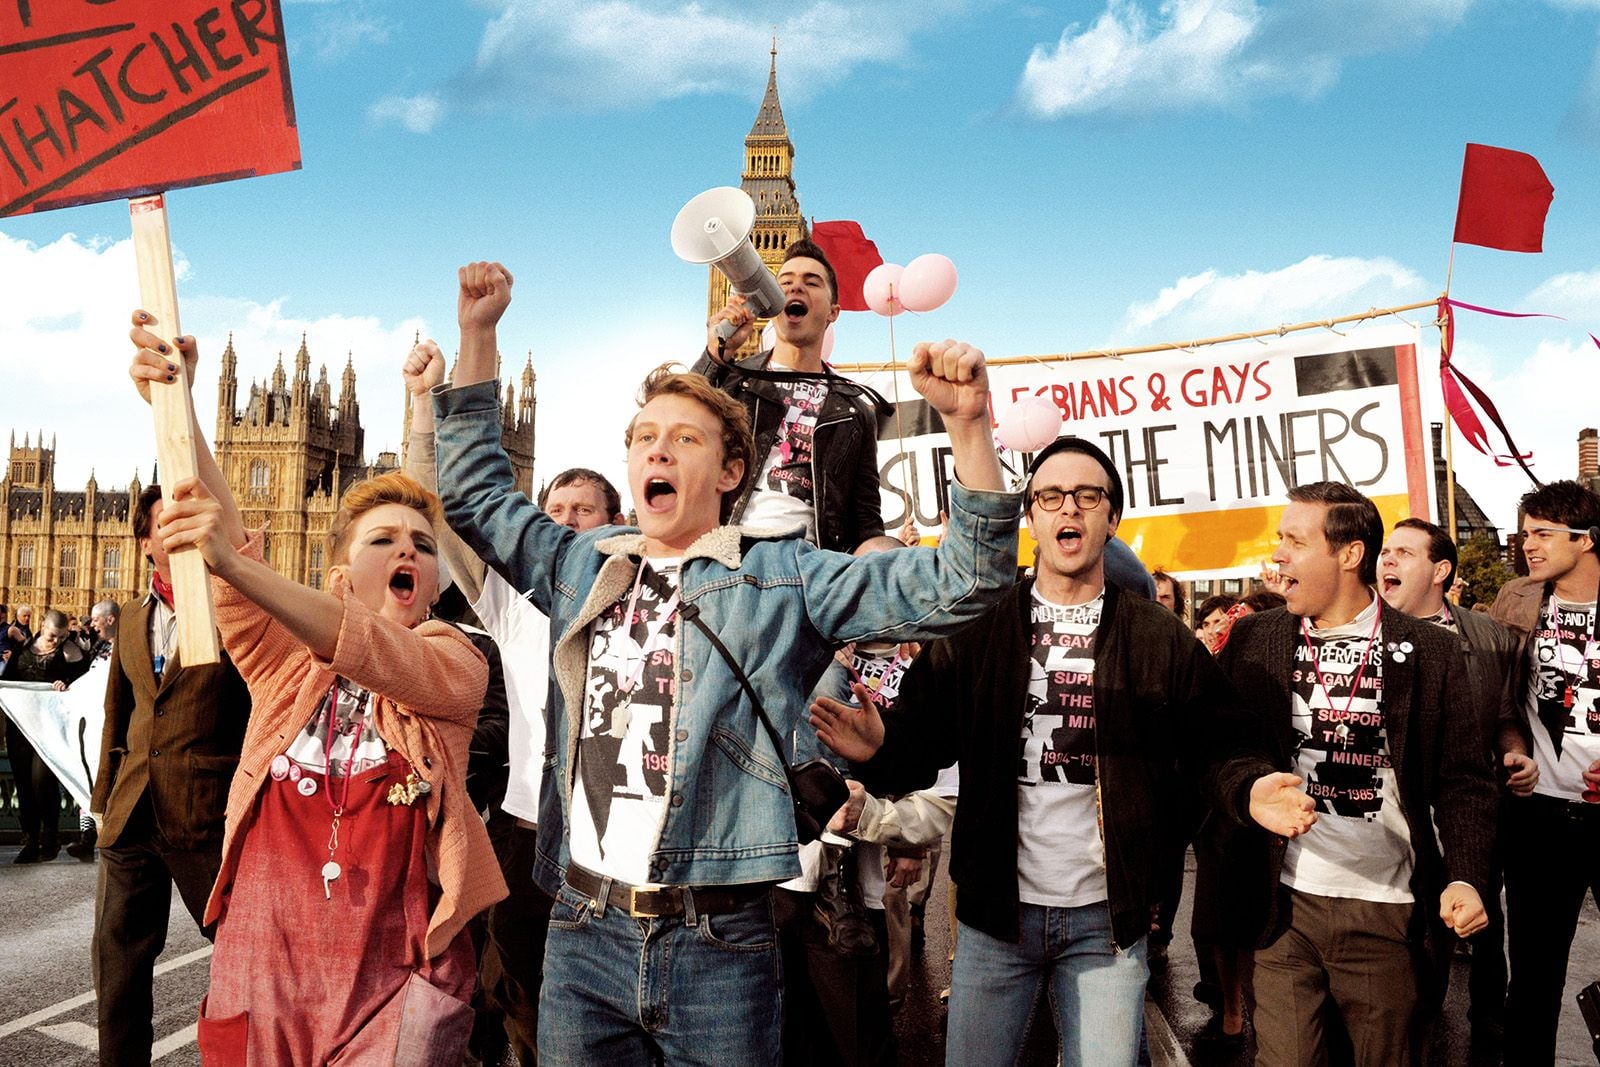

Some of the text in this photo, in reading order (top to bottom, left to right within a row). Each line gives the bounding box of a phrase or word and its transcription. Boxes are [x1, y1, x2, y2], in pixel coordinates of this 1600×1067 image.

[0, 0, 279, 188] THATCHER
[1148, 372, 1172, 412] &
[1181, 360, 1272, 408] GAYS
[1099, 424, 1184, 509] THE
[1203, 401, 1389, 502] MINERS
[1564, 612, 1586, 627] AND
[1041, 633, 1052, 646] &
[1058, 634, 1093, 649] GAY
[1294, 645, 1319, 662] AND
[1306, 671, 1317, 684] &
[1322, 673, 1354, 688] GAY
[1059, 693, 1093, 709] THE
[1332, 750, 1392, 769] MINERS
[1308, 782, 1375, 801] 1984-1985
